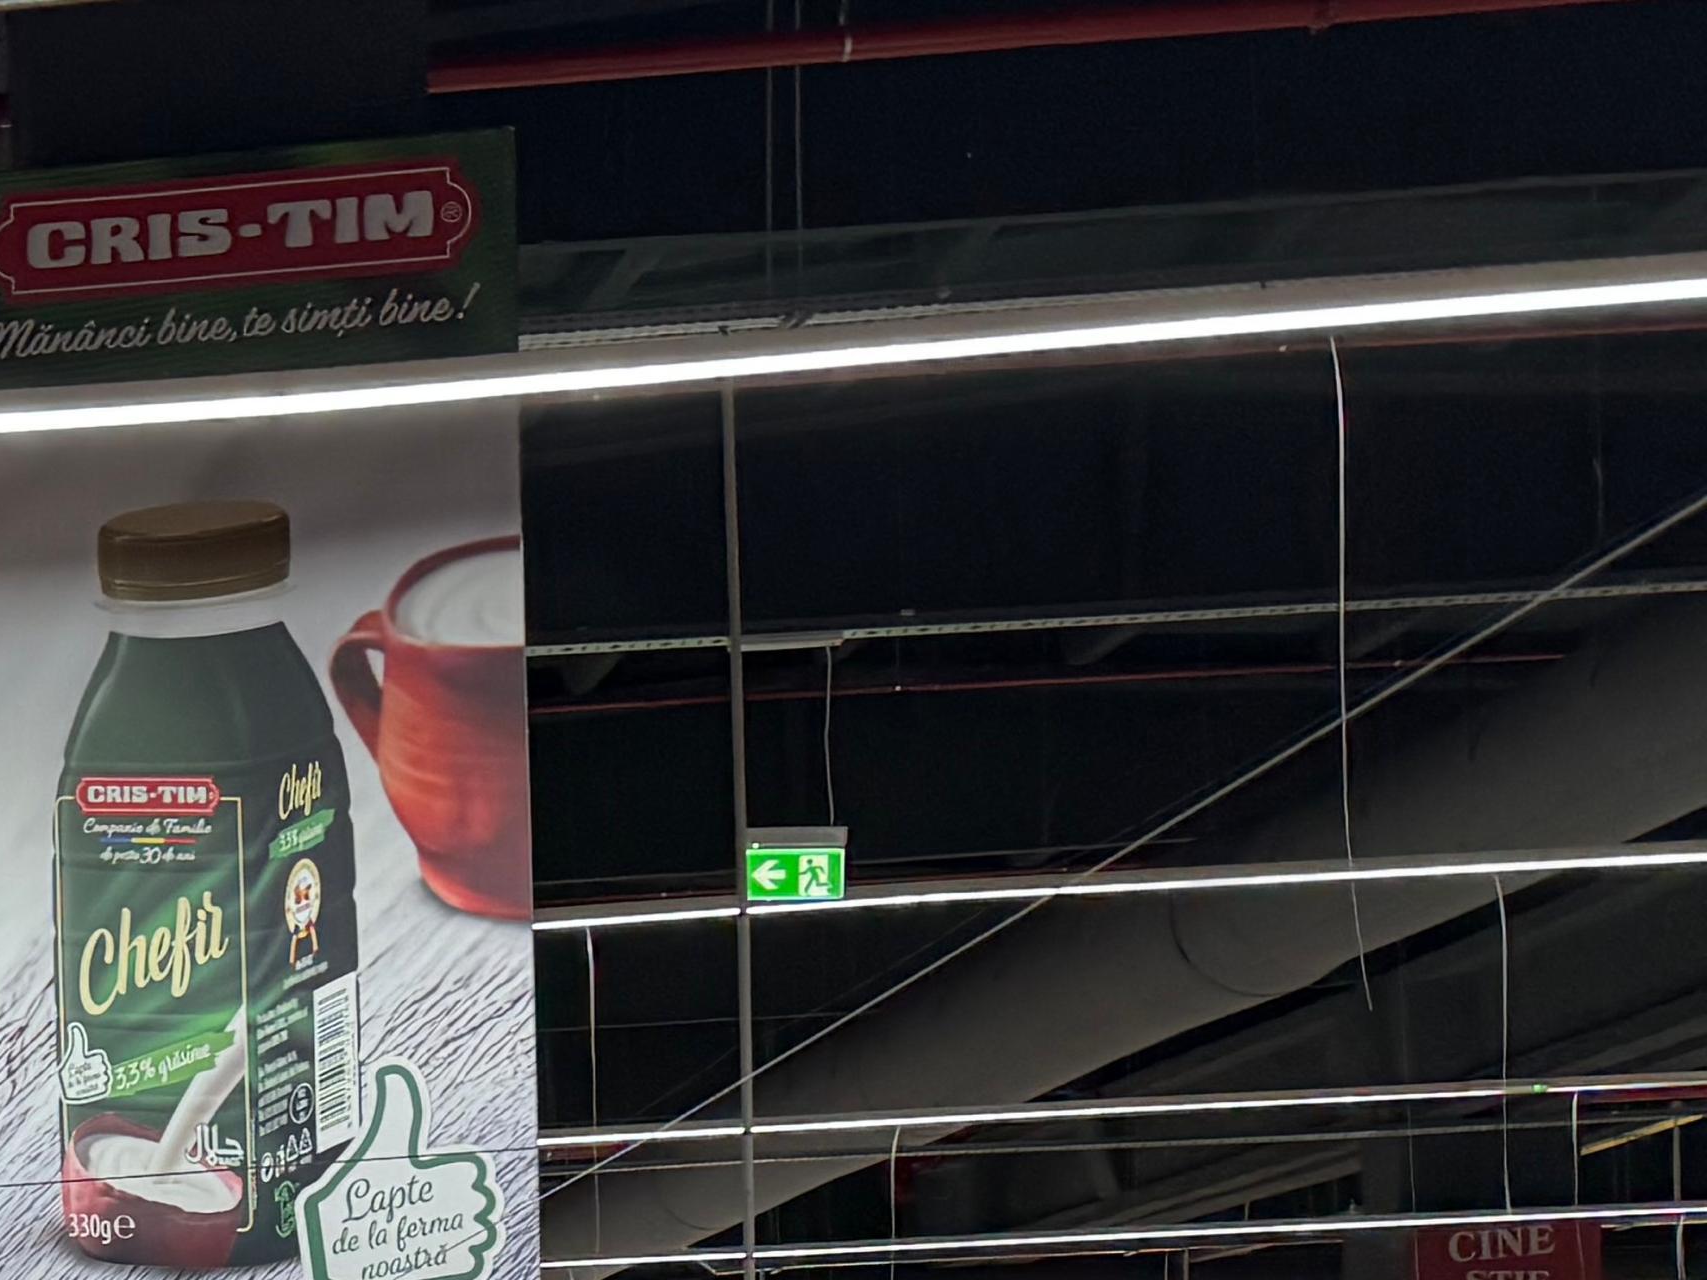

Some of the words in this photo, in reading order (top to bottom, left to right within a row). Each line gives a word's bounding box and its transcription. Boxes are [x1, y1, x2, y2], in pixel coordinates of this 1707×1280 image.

[26, 190, 434, 269] CRIS-TIM
[243, 304, 277, 337] te
[281, 288, 373, 339] simți
[87, 785, 207, 804] CRIS-TIM
[279, 761, 322, 820] Chefir
[140, 847, 161, 864] 30
[79, 891, 228, 1016] Chefir
[342, 1175, 434, 1224] Lapte
[332, 1227, 360, 1255] de
[368, 1220, 387, 1249] la
[396, 1213, 464, 1252] ferma
[1448, 1225, 1556, 1263] CINE
[361, 1243, 448, 1280] noastră
